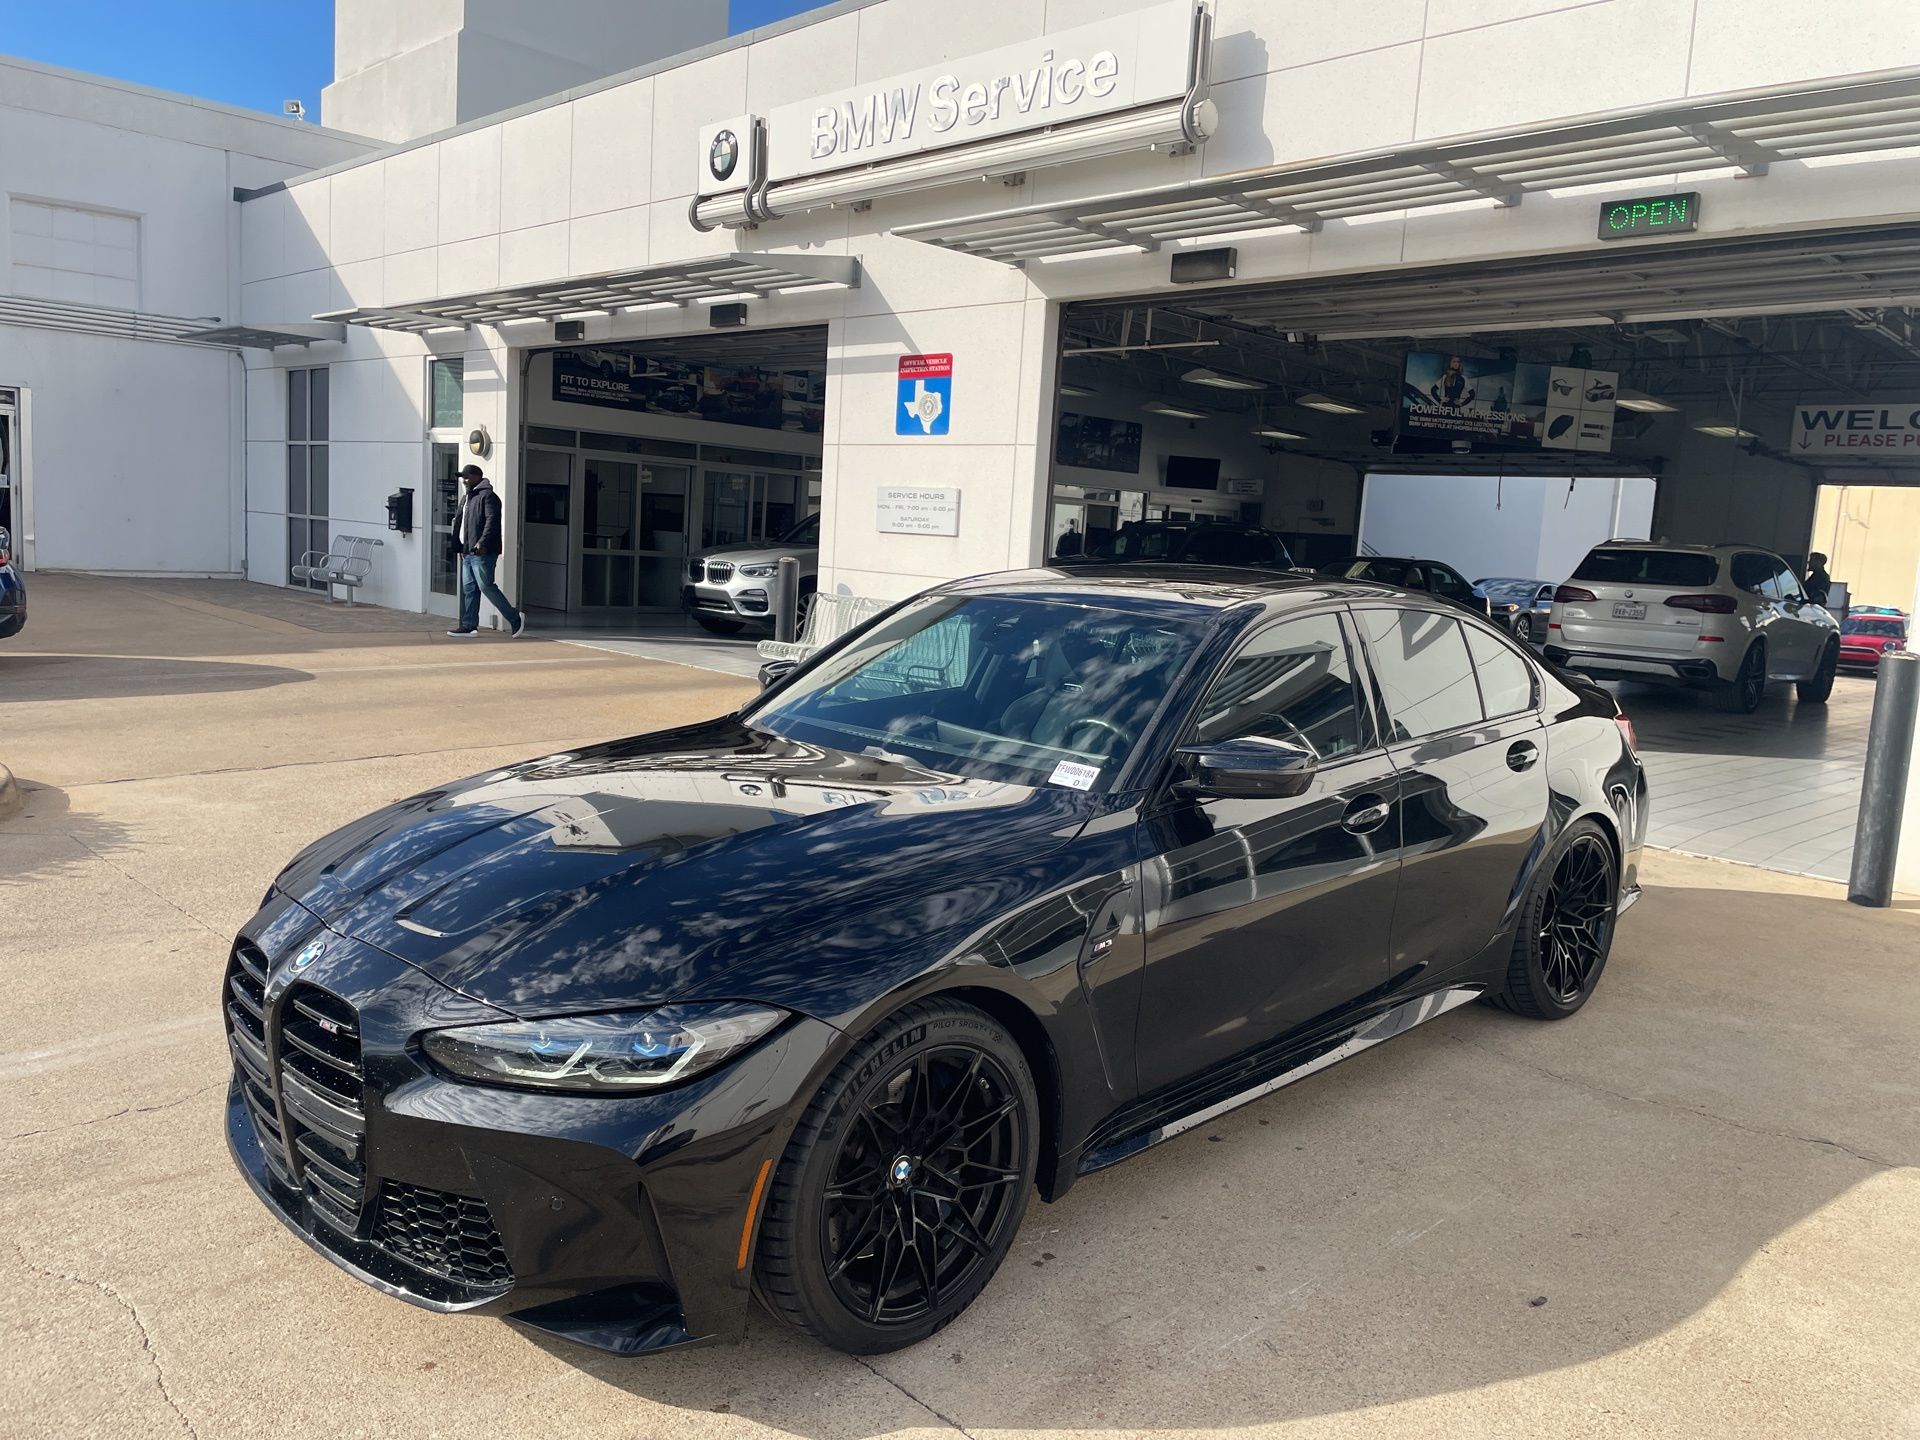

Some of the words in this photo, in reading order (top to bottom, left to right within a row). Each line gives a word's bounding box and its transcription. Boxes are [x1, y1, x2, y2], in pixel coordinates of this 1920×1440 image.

[811, 83, 921, 160] BMW
[927, 48, 1118, 133] Service
[1609, 199, 1687, 230] OPEN
[560, 374, 574, 384] FIT
[576, 376, 588, 386] TO
[1409, 403, 1462, 417] POWERFUL
[1463, 408, 1529, 424] IMPRESSIONS.
[1824, 433, 1897, 447] PLEASE
[933, 1020, 956, 1030] PILOT
[958, 1020, 983, 1034] SPORT
[837, 1026, 922, 1112] MICHELIN
